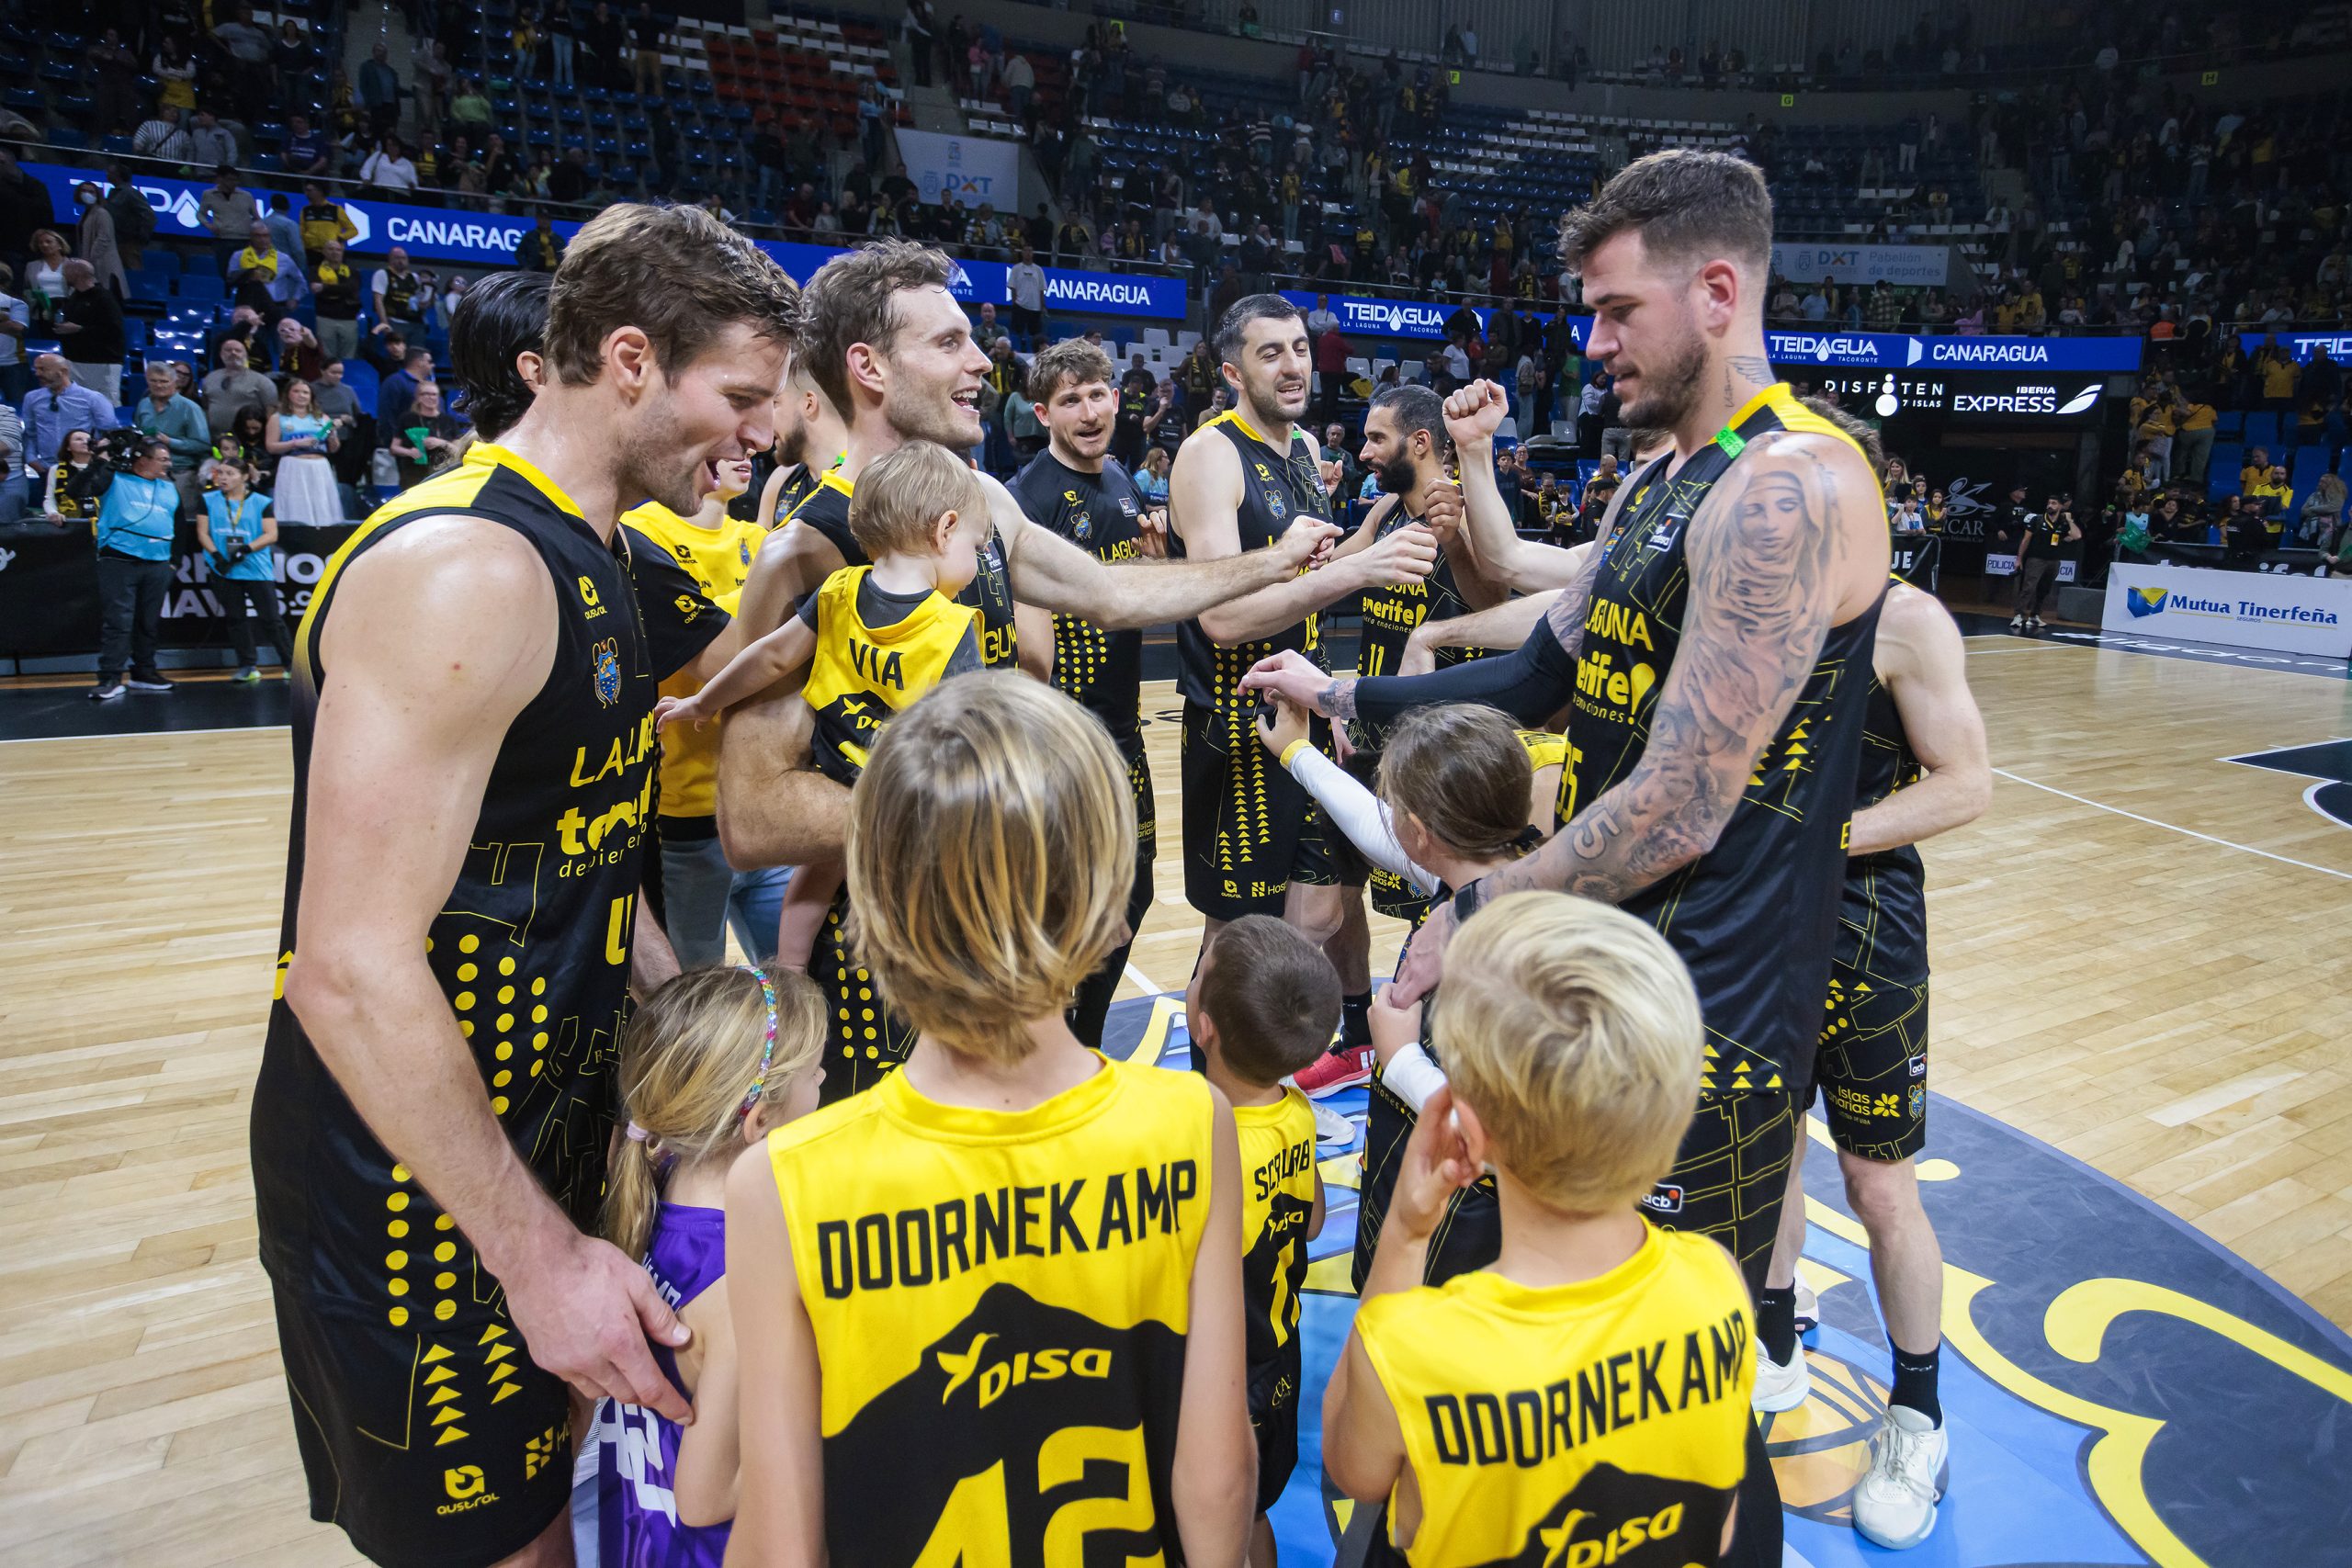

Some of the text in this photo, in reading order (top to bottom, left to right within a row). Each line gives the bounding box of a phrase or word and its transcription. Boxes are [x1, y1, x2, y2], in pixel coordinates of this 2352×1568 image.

[945, 173, 992, 194] DXT
[387, 217, 526, 252] CANARAG
[1818, 250, 1860, 265] DXT
[1869, 250, 1921, 264] Pabellón
[1868, 265, 1940, 277] de deportes
[1044, 278, 1151, 306] ANARAGUA
[1343, 302, 1444, 328] TEIDAGUA
[1410, 326, 1442, 334] TACORONT
[1770, 335, 1879, 356] TEIDAGUA
[1932, 344, 2049, 362] CANARAGUA
[1838, 355, 1878, 364] TACORONTE
[2016, 386, 2056, 394] IBERIA
[1902, 399, 1942, 408] 7 ISLAS
[1953, 395, 2056, 412] EXPRESS
[1942, 518, 1984, 536] ICAR
[1100, 538, 1144, 565] LAGU
[2169, 594, 2338, 625] Mutua Tinerfeña
[849, 637, 905, 691] VIA
[1838, 1084, 1871, 1104] Islas
[1641, 1193, 1671, 1208] acb
[816, 1158, 1196, 1301] DOORNEKAMP
[1423, 1308, 1747, 1469] DOORNEKAMP
[436, 1492, 501, 1516] austral
